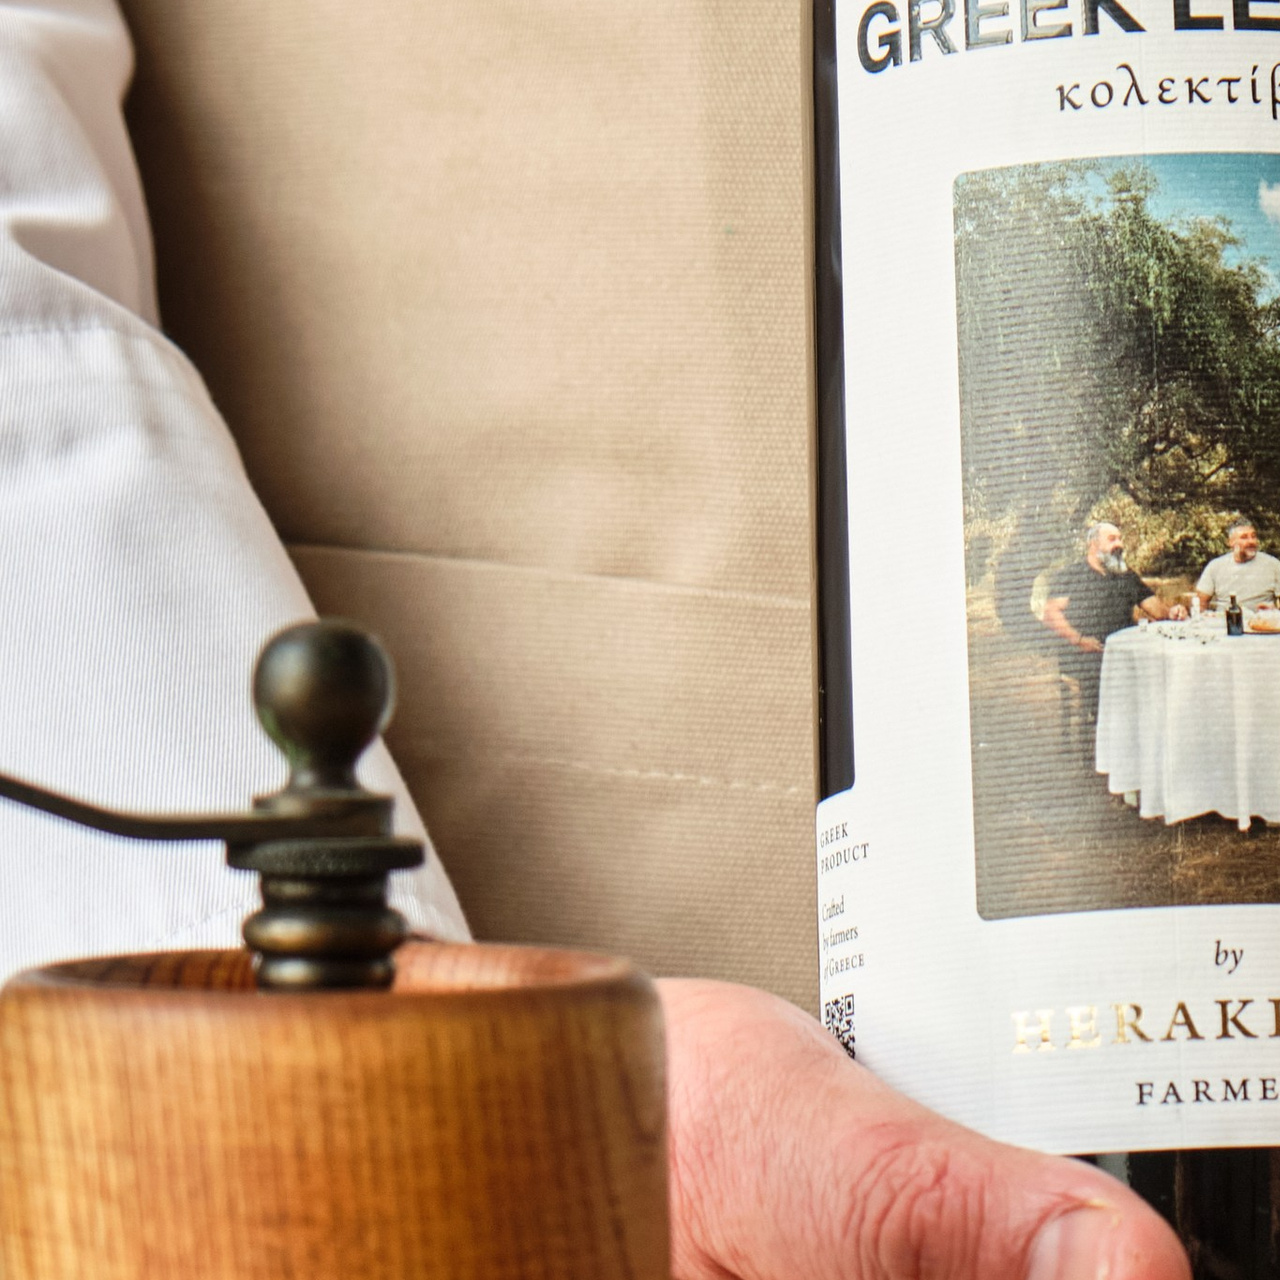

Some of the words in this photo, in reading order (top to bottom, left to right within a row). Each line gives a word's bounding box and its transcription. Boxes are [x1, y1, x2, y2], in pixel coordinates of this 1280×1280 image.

[820, 822, 849, 848] GREEK
[820, 842, 870, 875] PRODUCT
[1214, 940, 1244, 974] by
